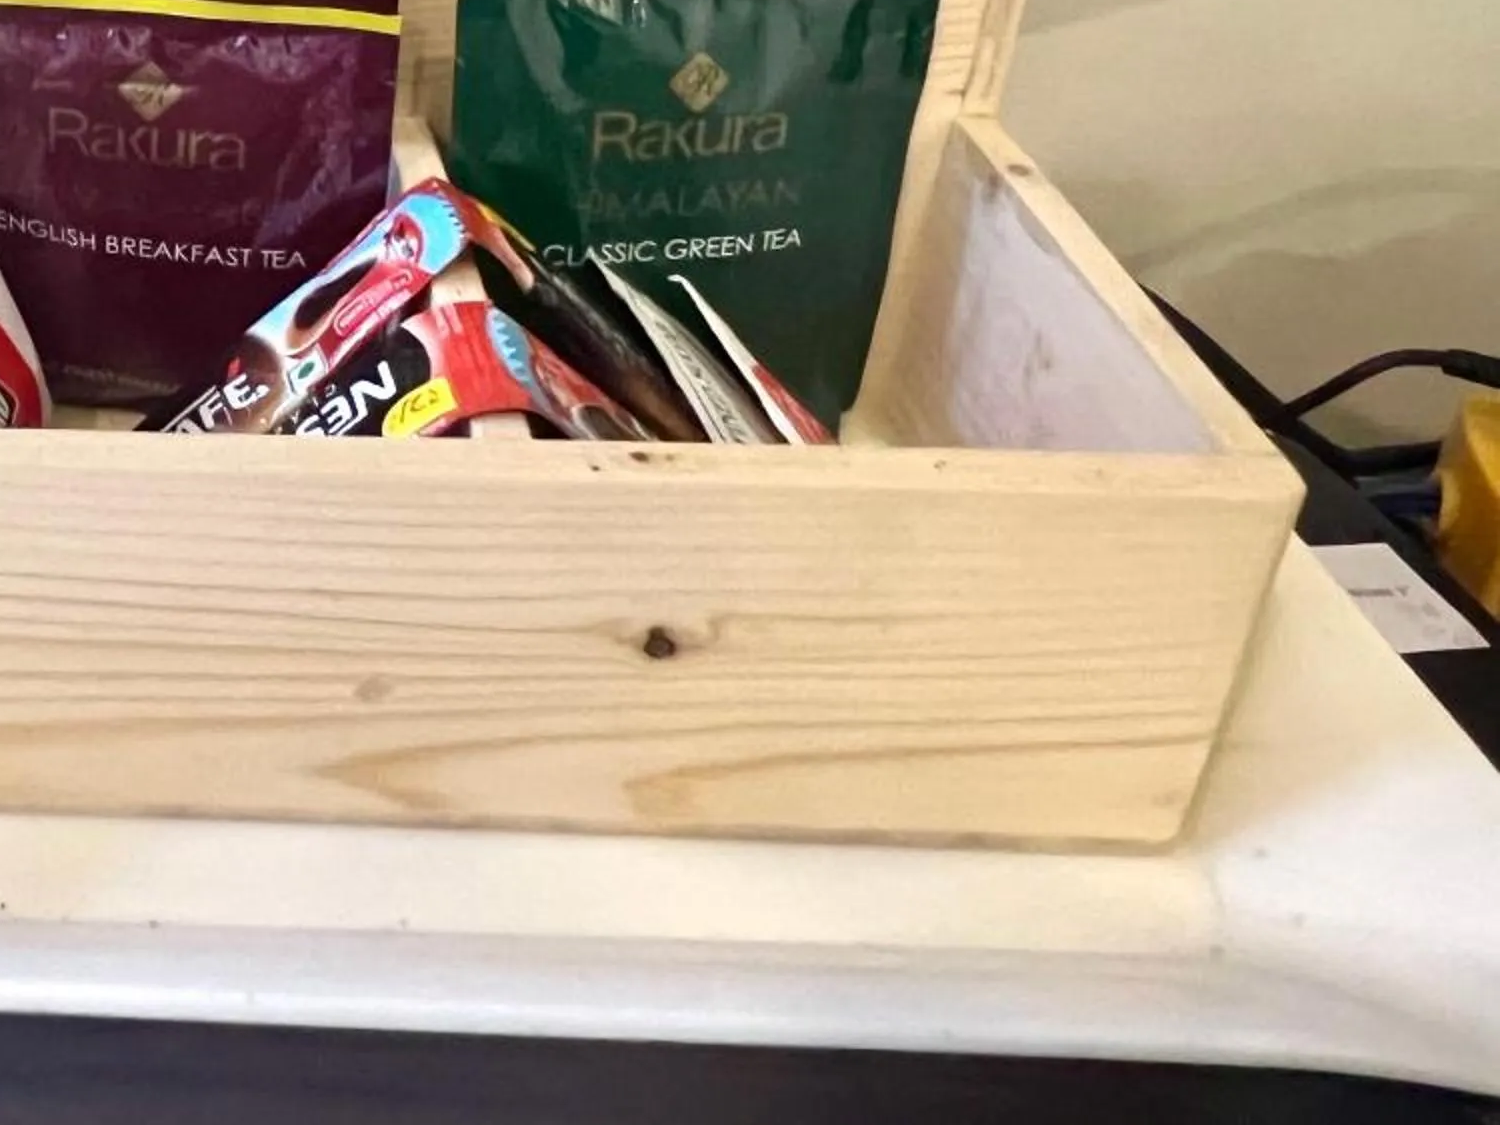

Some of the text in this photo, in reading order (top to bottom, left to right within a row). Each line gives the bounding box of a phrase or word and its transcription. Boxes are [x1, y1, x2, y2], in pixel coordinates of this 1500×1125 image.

[46, 106, 248, 172] Rakura
[592, 110, 789, 162] Rakura
[105, 236, 252, 269] BREAKFAST
[261, 250, 308, 271] TEA
[543, 228, 802, 266] CLASSIC GREEN TEA
